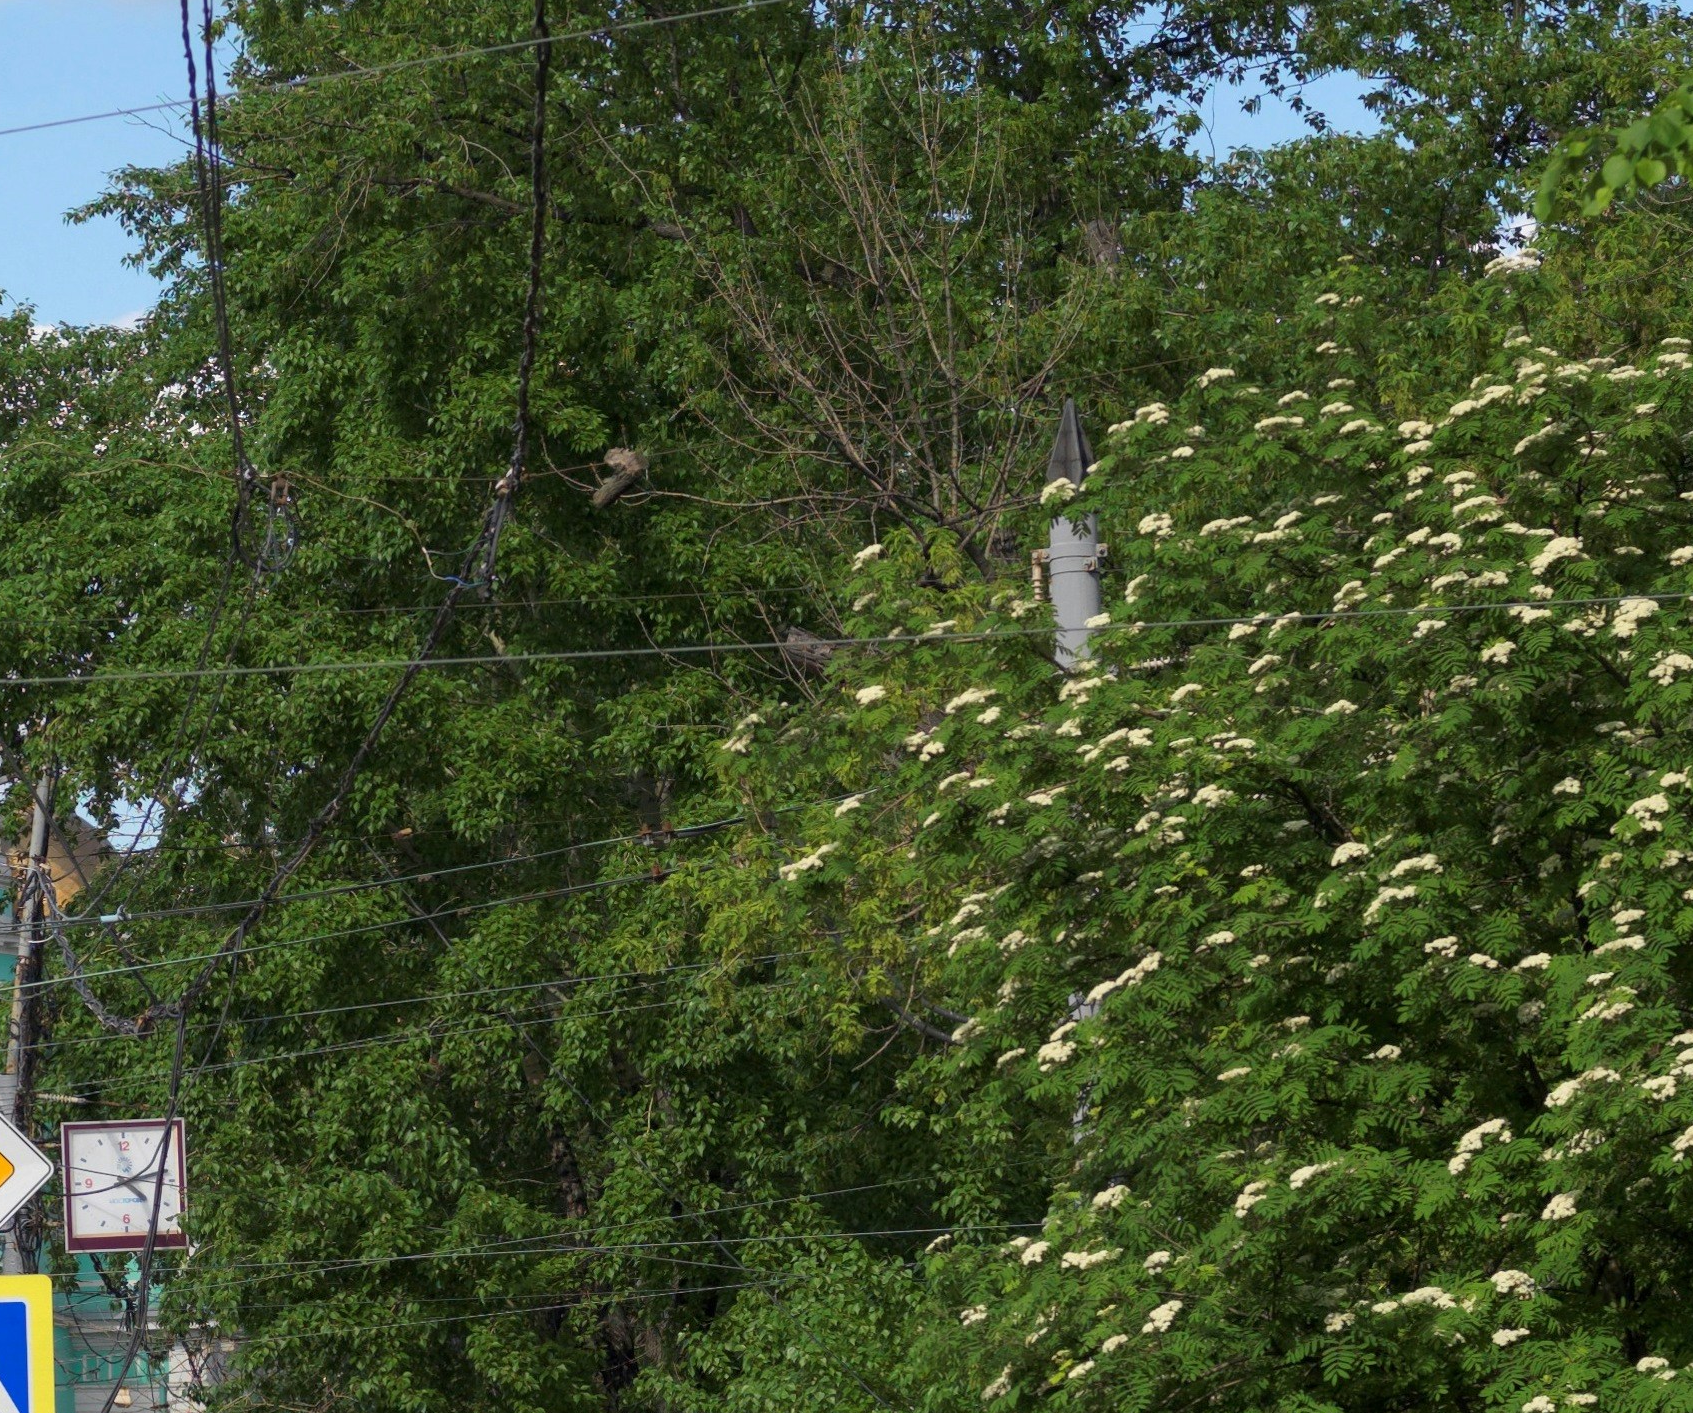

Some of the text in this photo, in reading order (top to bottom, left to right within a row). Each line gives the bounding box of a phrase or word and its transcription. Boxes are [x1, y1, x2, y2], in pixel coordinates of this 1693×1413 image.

[119, 1140, 130, 1151] 12
[84, 1178, 93, 1188] 9
[122, 1213, 131, 1224] 6
